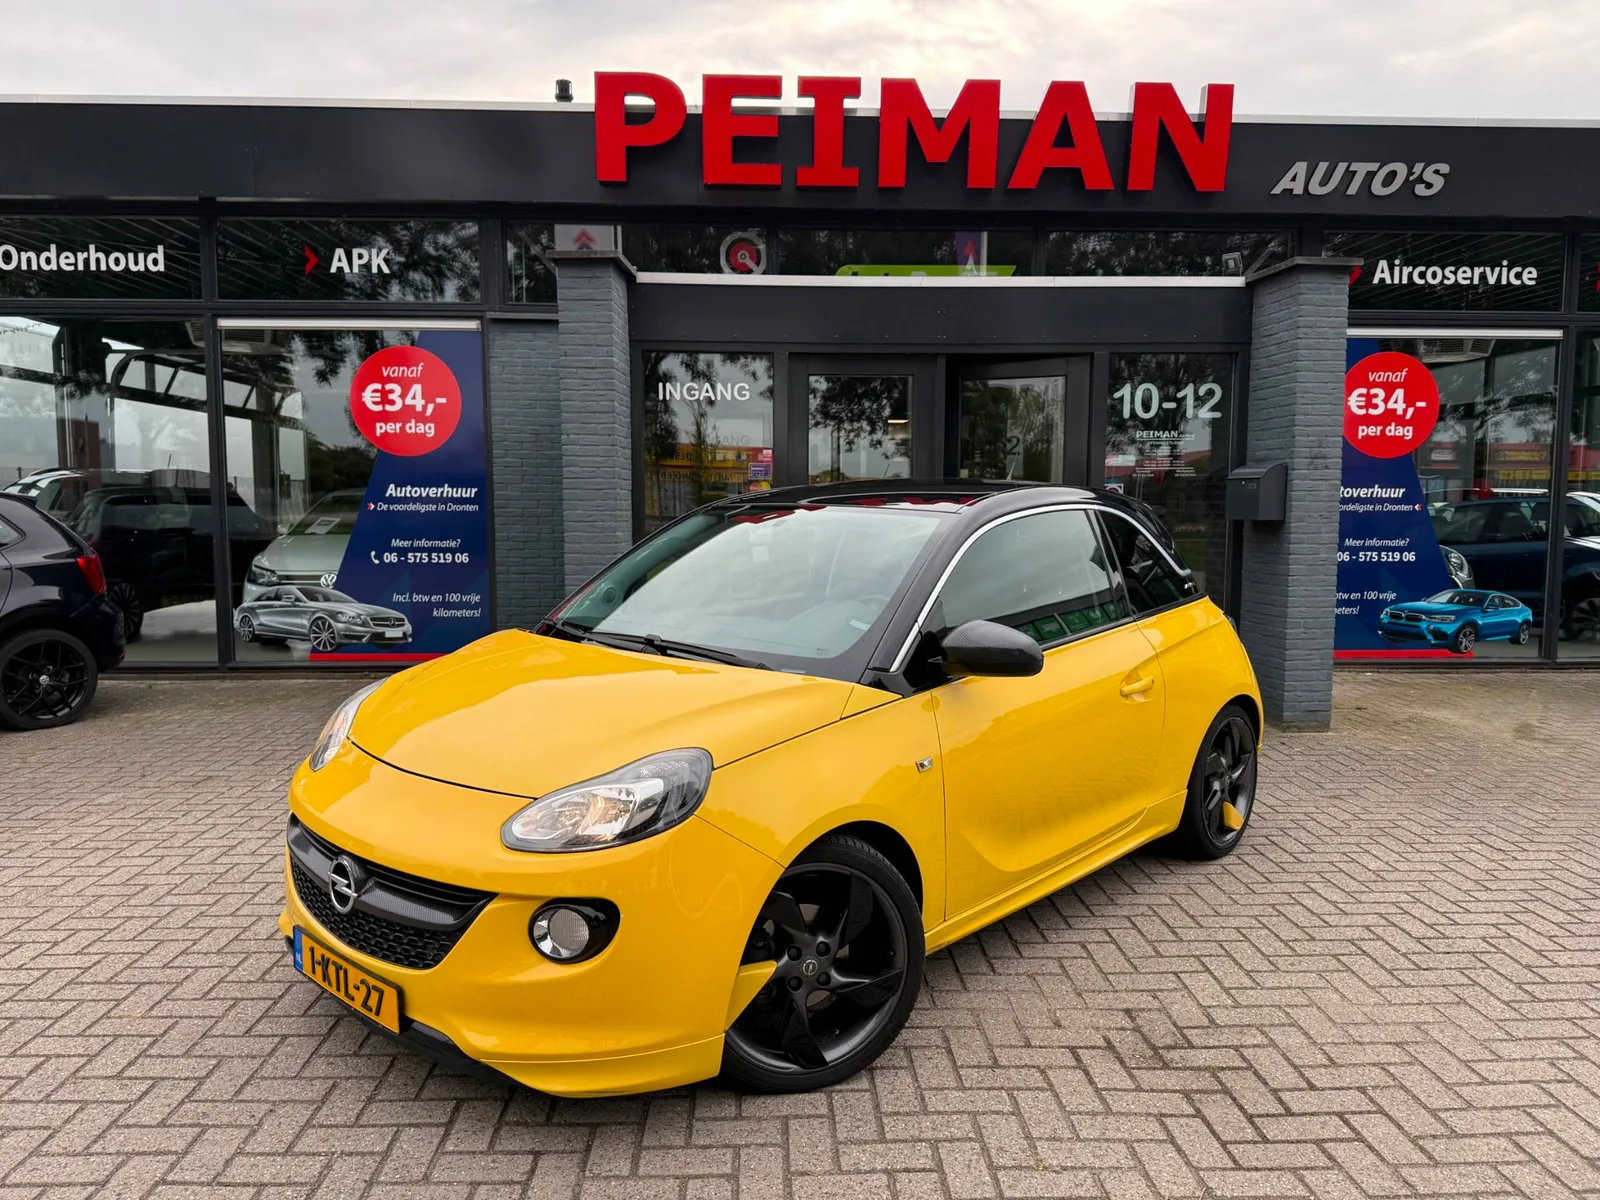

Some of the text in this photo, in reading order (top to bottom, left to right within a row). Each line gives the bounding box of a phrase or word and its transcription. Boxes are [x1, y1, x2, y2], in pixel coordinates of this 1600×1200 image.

[594, 71, 1235, 192] PEIMAN
[1270, 161, 1450, 197] AUTO'S
[0, 243, 165, 273] Onderhoud
[329, 247, 391, 275] APK
[1372, 259, 1538, 286] Aircoservice
[381, 362, 424, 378] vanaf
[1368, 367, 1409, 383] vanaf
[658, 381, 750, 401] INGANG
[361, 382, 447, 417] €34,-
[1113, 382, 1223, 419] 10-12
[1347, 387, 1427, 420] €34,-
[375, 418, 435, 438] per dag
[1136, 430, 1179, 438] PEIMAN
[1357, 421, 1414, 440] per dag
[385, 483, 478, 498] Autoverhuur
[1340, 484, 1406, 498] toverhuur
[376, 502, 479, 513] De voordeligste in Dronten
[1339, 503, 1413, 513] ordeligste in Dronten
[391, 538, 461, 548] Meer informatie?
[1344, 537, 1410, 547] Meer informatie?
[383, 552, 398, 563] 06
[407, 552, 429, 563] 575
[431, 552, 452, 563] 519
[454, 552, 470, 563] 06
[1336, 551, 1350, 562] 06
[1358, 551, 1378, 562] 575
[1380, 551, 1400, 562] 519
[1402, 551, 1416, 562] 06
[393, 592, 411, 602] Incl.
[412, 592, 430, 602] btw
[444, 593, 461, 602] 100
[462, 592, 481, 605] vrije
[1363, 591, 1378, 600] 100
[1379, 591, 1397, 602] vrije
[433, 607, 481, 617] kilometers!
[309, 945, 385, 1017] 1-KTL-27
